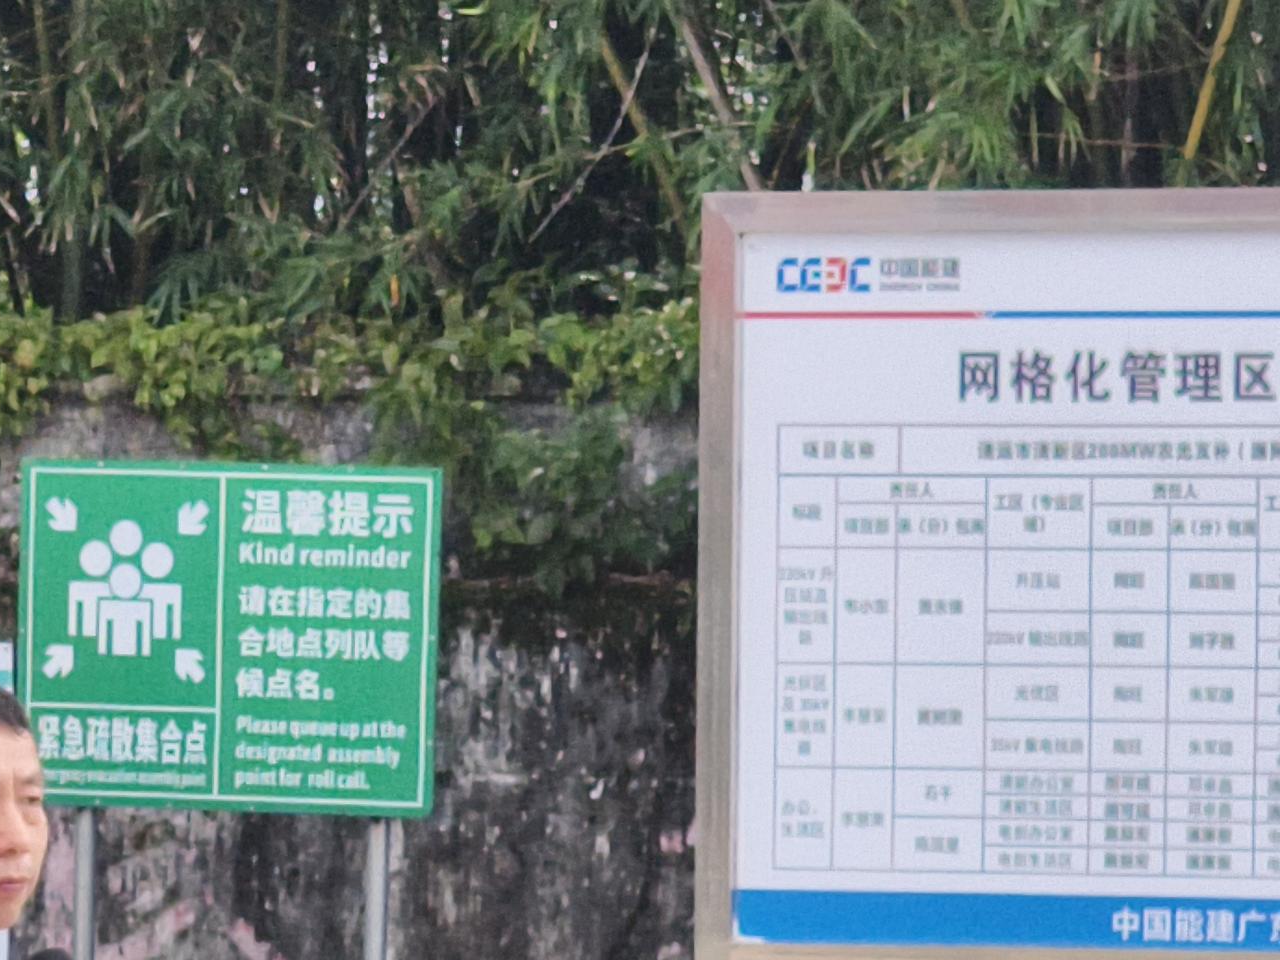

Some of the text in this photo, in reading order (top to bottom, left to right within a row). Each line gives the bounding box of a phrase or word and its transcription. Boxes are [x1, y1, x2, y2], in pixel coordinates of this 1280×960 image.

[958, 351, 1277, 402] 网格化管理区
[241, 489, 414, 538] 温馨提示
[239, 542, 411, 569] Kind reminder
[239, 586, 411, 620] 请在指定的集
[238, 629, 410, 661] 合地点列队等
[236, 669, 335, 701] 候点名。
[38, 714, 208, 766] 紧急疏散集合点
[236, 715, 288, 734] Please
